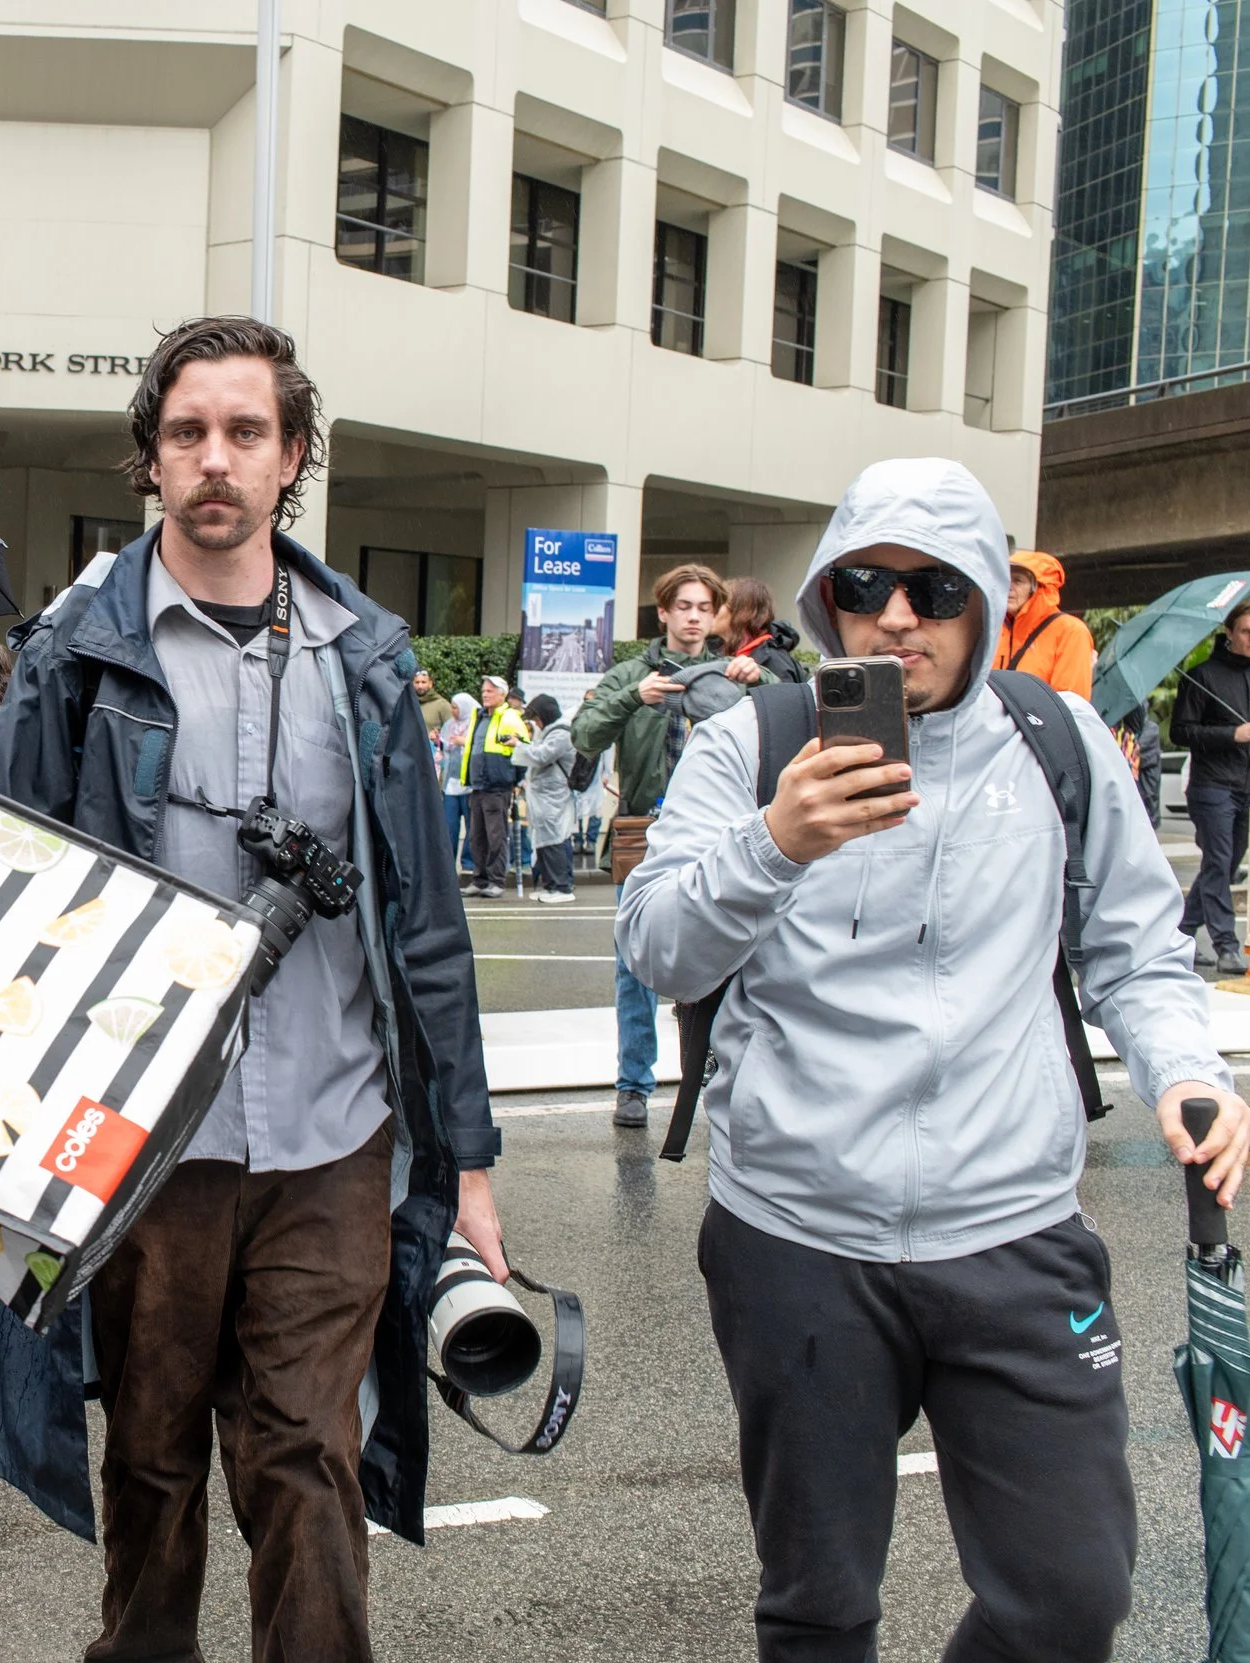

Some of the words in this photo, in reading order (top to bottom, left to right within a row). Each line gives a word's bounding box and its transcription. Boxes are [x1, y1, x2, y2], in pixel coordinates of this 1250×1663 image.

[534, 536, 562, 555] For
[534, 556, 581, 576] Lease
[276, 566, 288, 621] SONY
[55, 1107, 106, 1173] coles
[536, 1385, 572, 1449] SONY
